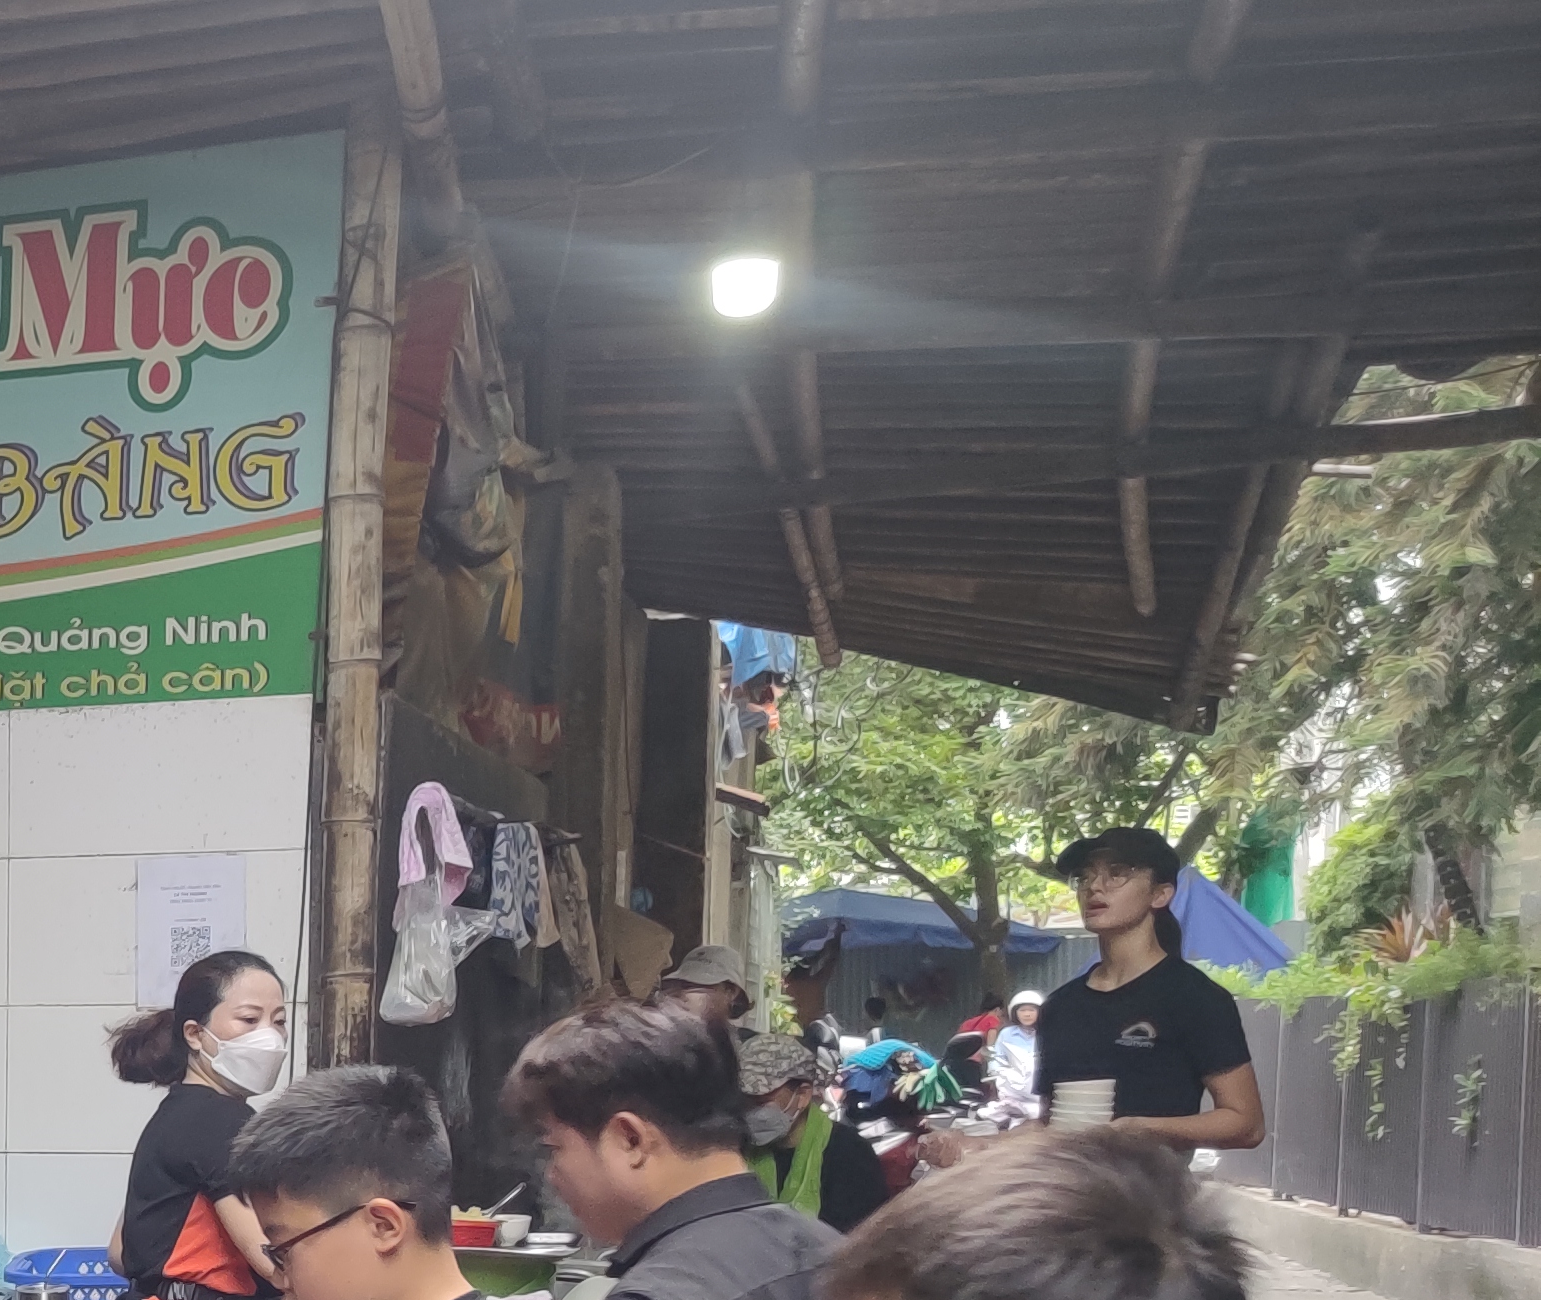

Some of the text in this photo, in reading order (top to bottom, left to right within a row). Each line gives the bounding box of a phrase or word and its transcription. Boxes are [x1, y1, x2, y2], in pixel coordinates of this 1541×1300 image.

[164, 611, 268, 646] Ninh
[59, 661, 149, 700] chả
[160, 660, 270, 695] cân)
